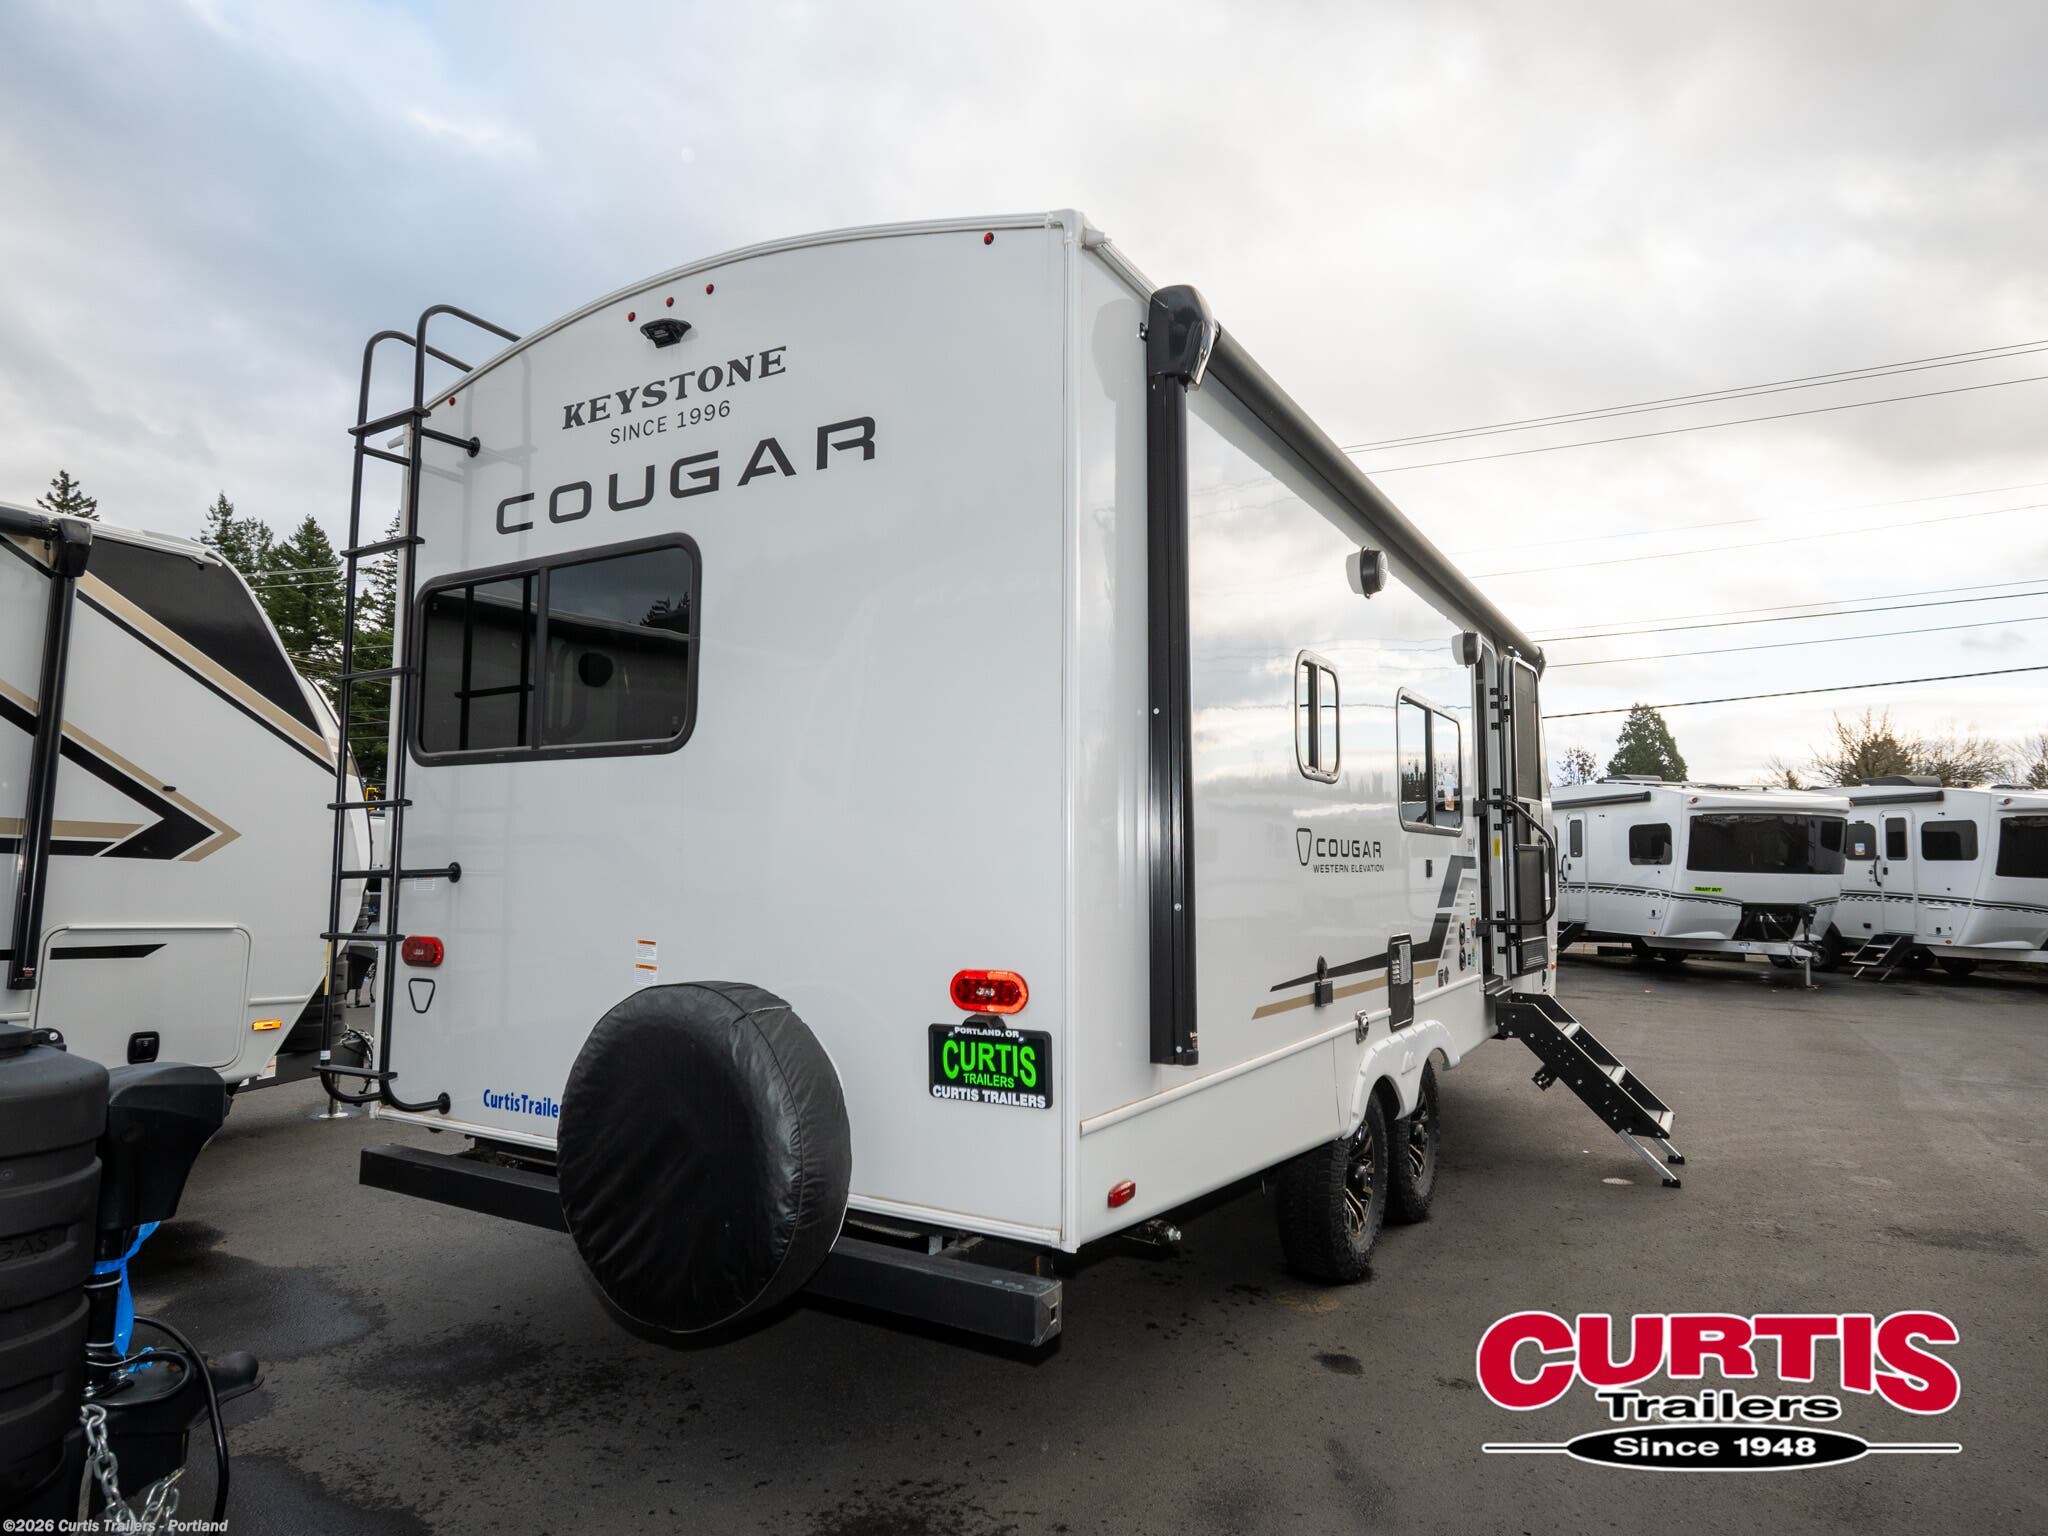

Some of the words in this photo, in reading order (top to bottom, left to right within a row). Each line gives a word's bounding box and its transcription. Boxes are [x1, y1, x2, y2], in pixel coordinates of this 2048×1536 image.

[562, 346, 787, 430] KEYSTONE
[610, 420, 667, 444] SINCE
[677, 400, 731, 429] 1996
[496, 416, 876, 535] COUGAR
[1317, 838, 1382, 858] COUGAR
[1313, 864, 1349, 873] WESTERN
[1351, 864, 1385, 872] ELEVATION
[1005, 1030, 1020, 1038] OR
[943, 1039, 1037, 1087] CURTIS
[963, 1073, 1015, 1088] TRAILERS
[483, 1089, 562, 1118] CurtisTraile
[933, 1085, 980, 1101] CURTIS
[981, 1090, 1046, 1109] TRAILERS
